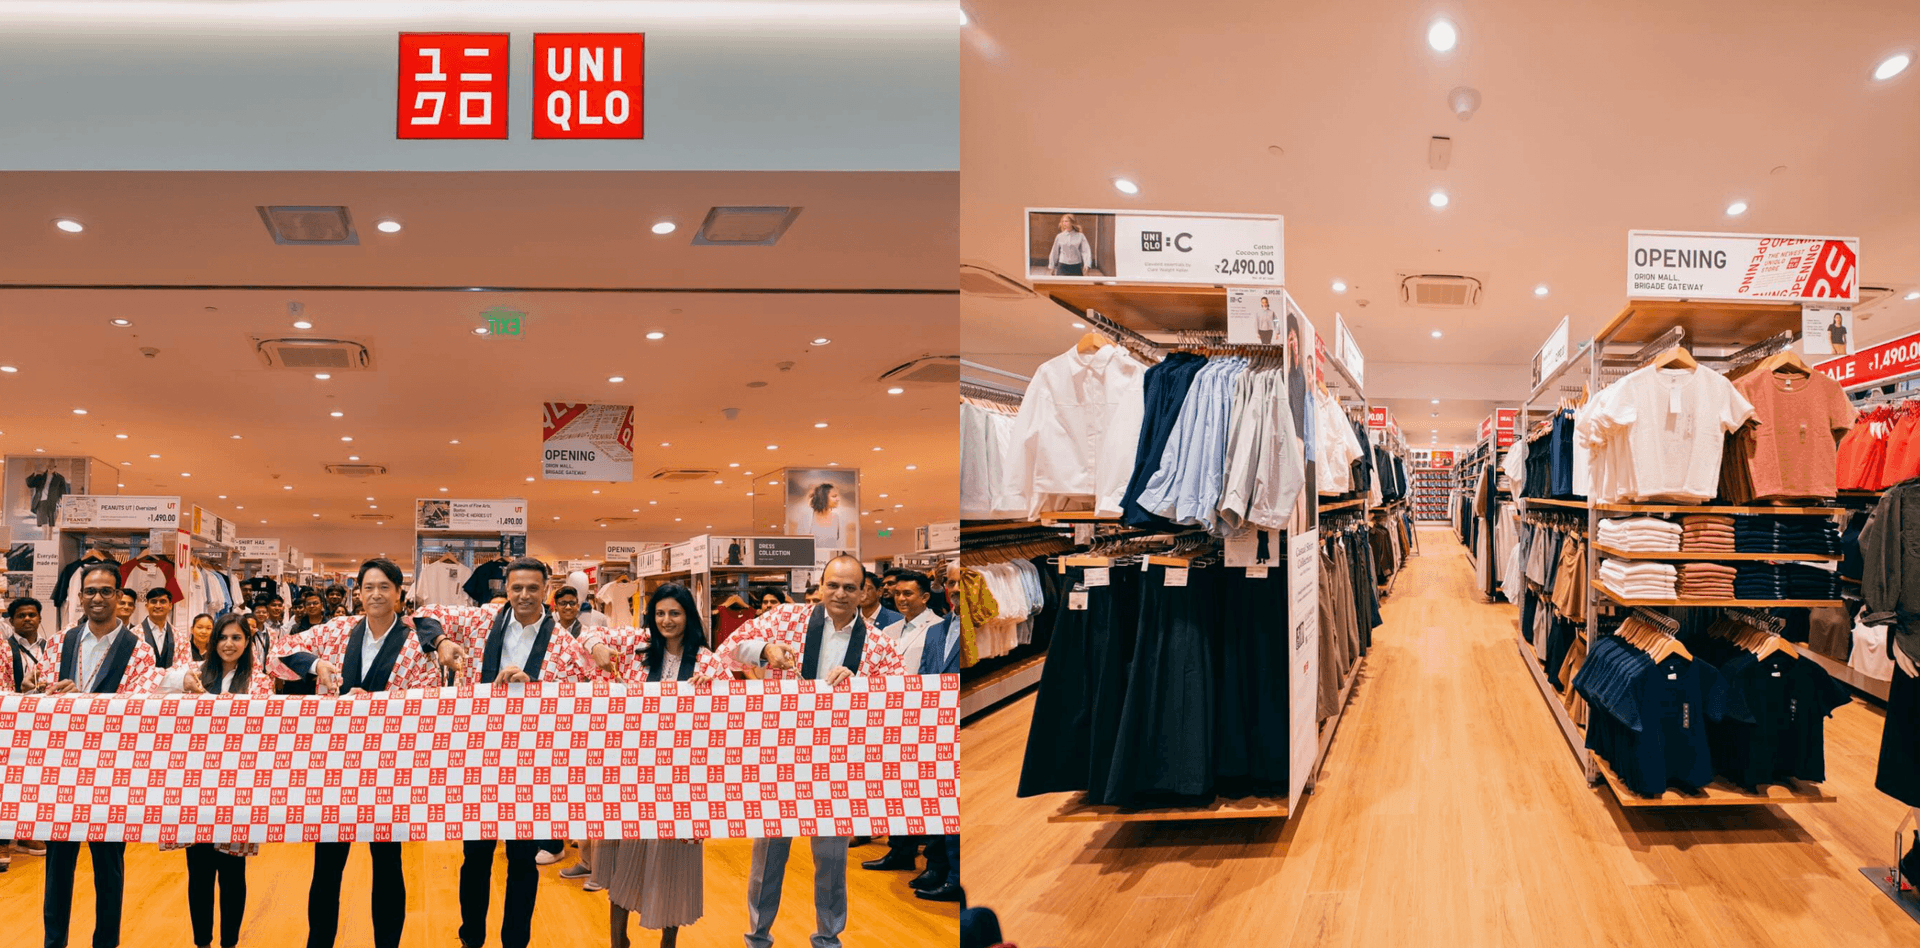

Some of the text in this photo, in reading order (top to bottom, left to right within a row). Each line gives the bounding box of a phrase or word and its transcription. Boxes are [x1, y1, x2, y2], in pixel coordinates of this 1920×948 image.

[414, 48, 493, 81] ユニ
[547, 47, 622, 82] UNI
[410, 91, 492, 125] クロ
[547, 90, 630, 131] QLO
[1143, 233, 1159, 241] UNI
[1143, 241, 1160, 250] QLO
[1780, 249, 1806, 257] NEWEST
[1634, 248, 1727, 269] OPENING
[1763, 258, 1786, 266] UNIQLO
[1215, 258, 1274, 276] ₹2,490.00
[1760, 265, 1781, 273] STORE
[1658, 273, 1680, 281] MALL,
[1634, 282, 1704, 291] BRIGADE GATEWAY
[1820, 361, 1856, 381] ALE
[545, 449, 596, 462] OPENING
[625, 722, 639, 730] QLO
[833, 719, 848, 727] QLO
[140, 725, 155, 733] QLO
[866, 753, 881, 761] QLO
[169, 760, 184, 768] QLO
[380, 760, 394, 768] QLO
[622, 757, 637, 766] QLO
[726, 792, 741, 800] QLO
[939, 788, 954, 796] QLO
[94, 795, 109, 803] QLO
[306, 796, 321, 804] QLO
[482, 794, 496, 802] QLO
[446, 831, 461, 839] QLO
[624, 830, 638, 838] QLO
[837, 827, 852, 835] QLO
[52, 832, 67, 840] QLO
[232, 834, 247, 842] QLO
